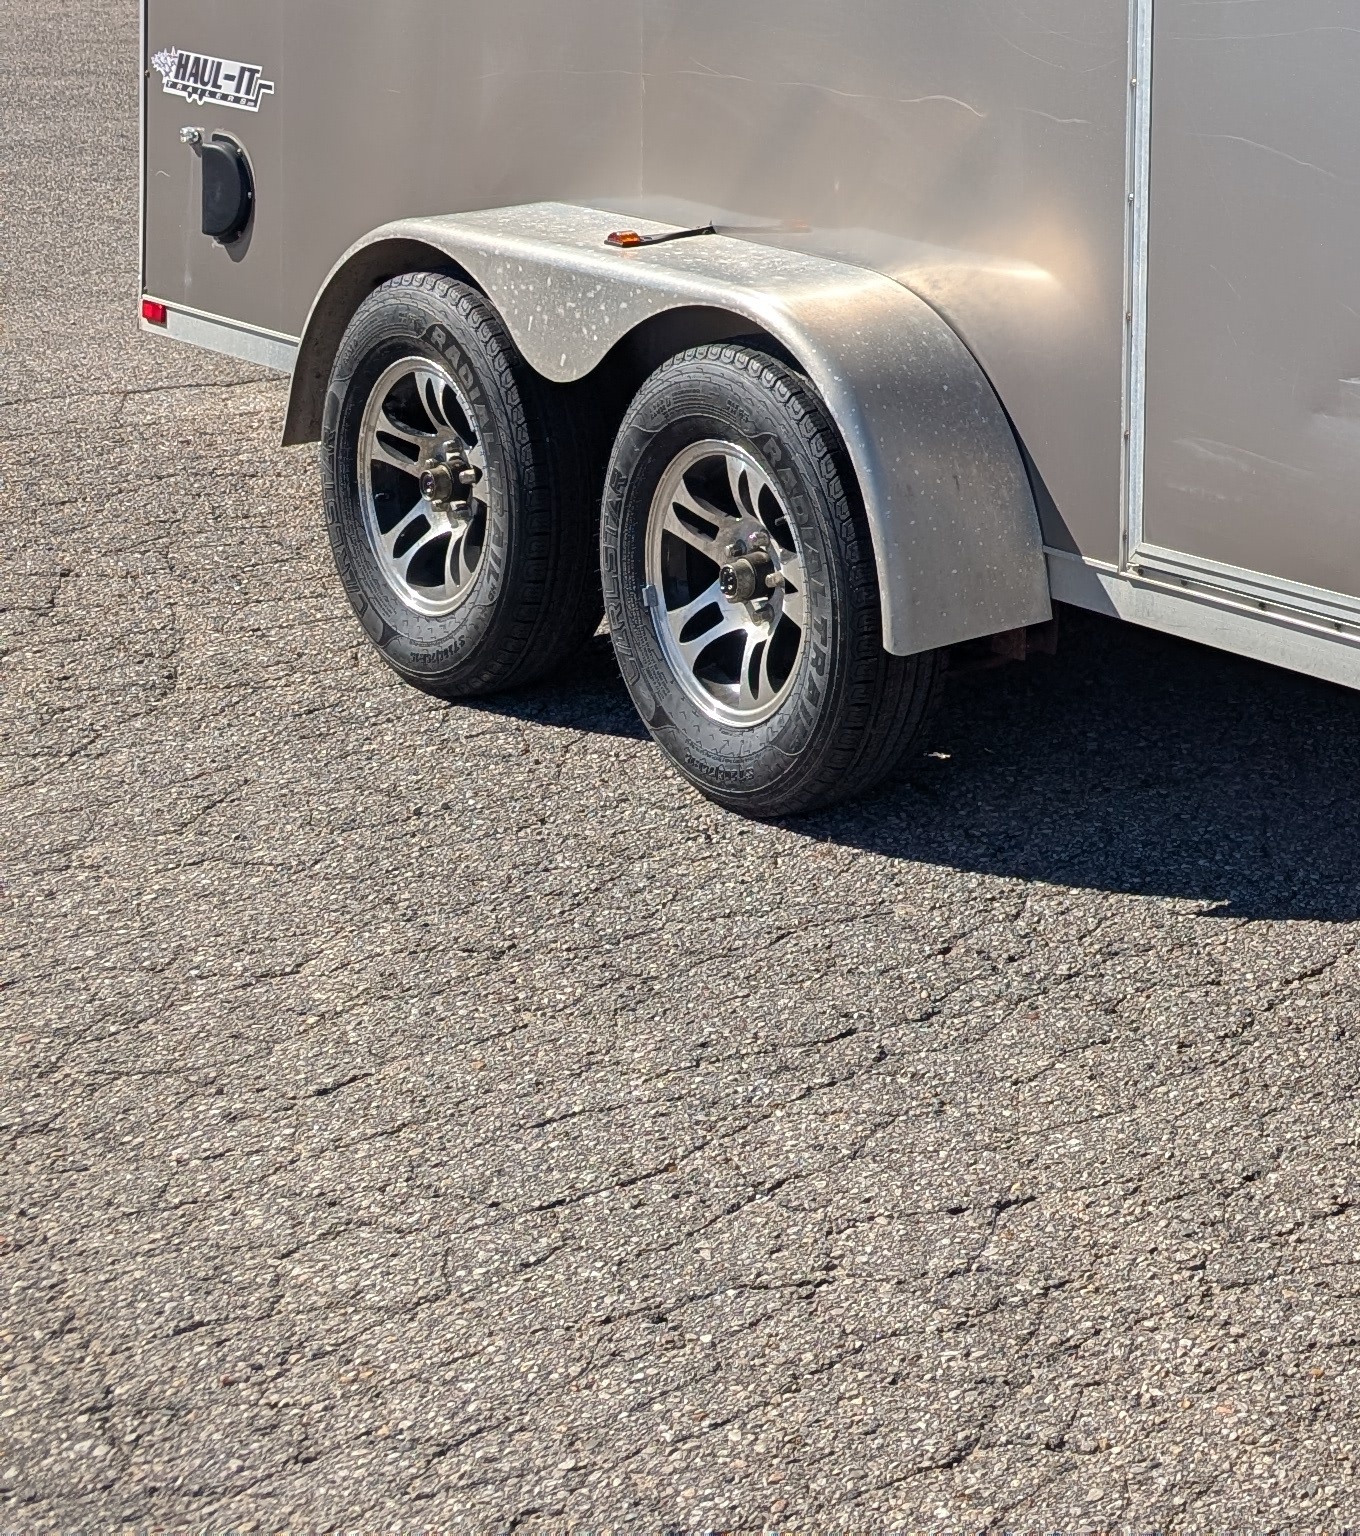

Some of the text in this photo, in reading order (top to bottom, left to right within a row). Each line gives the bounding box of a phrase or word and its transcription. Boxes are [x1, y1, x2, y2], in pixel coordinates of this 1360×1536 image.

[166, 80, 247, 106] TRAILERS
[174, 53, 261, 96] HAUL-IT
[430, 325, 494, 450] RADIAL
[488, 460, 505, 587] TRAIL
[762, 436, 828, 608] RADIAL
[603, 467, 640, 686] CARLSTAR
